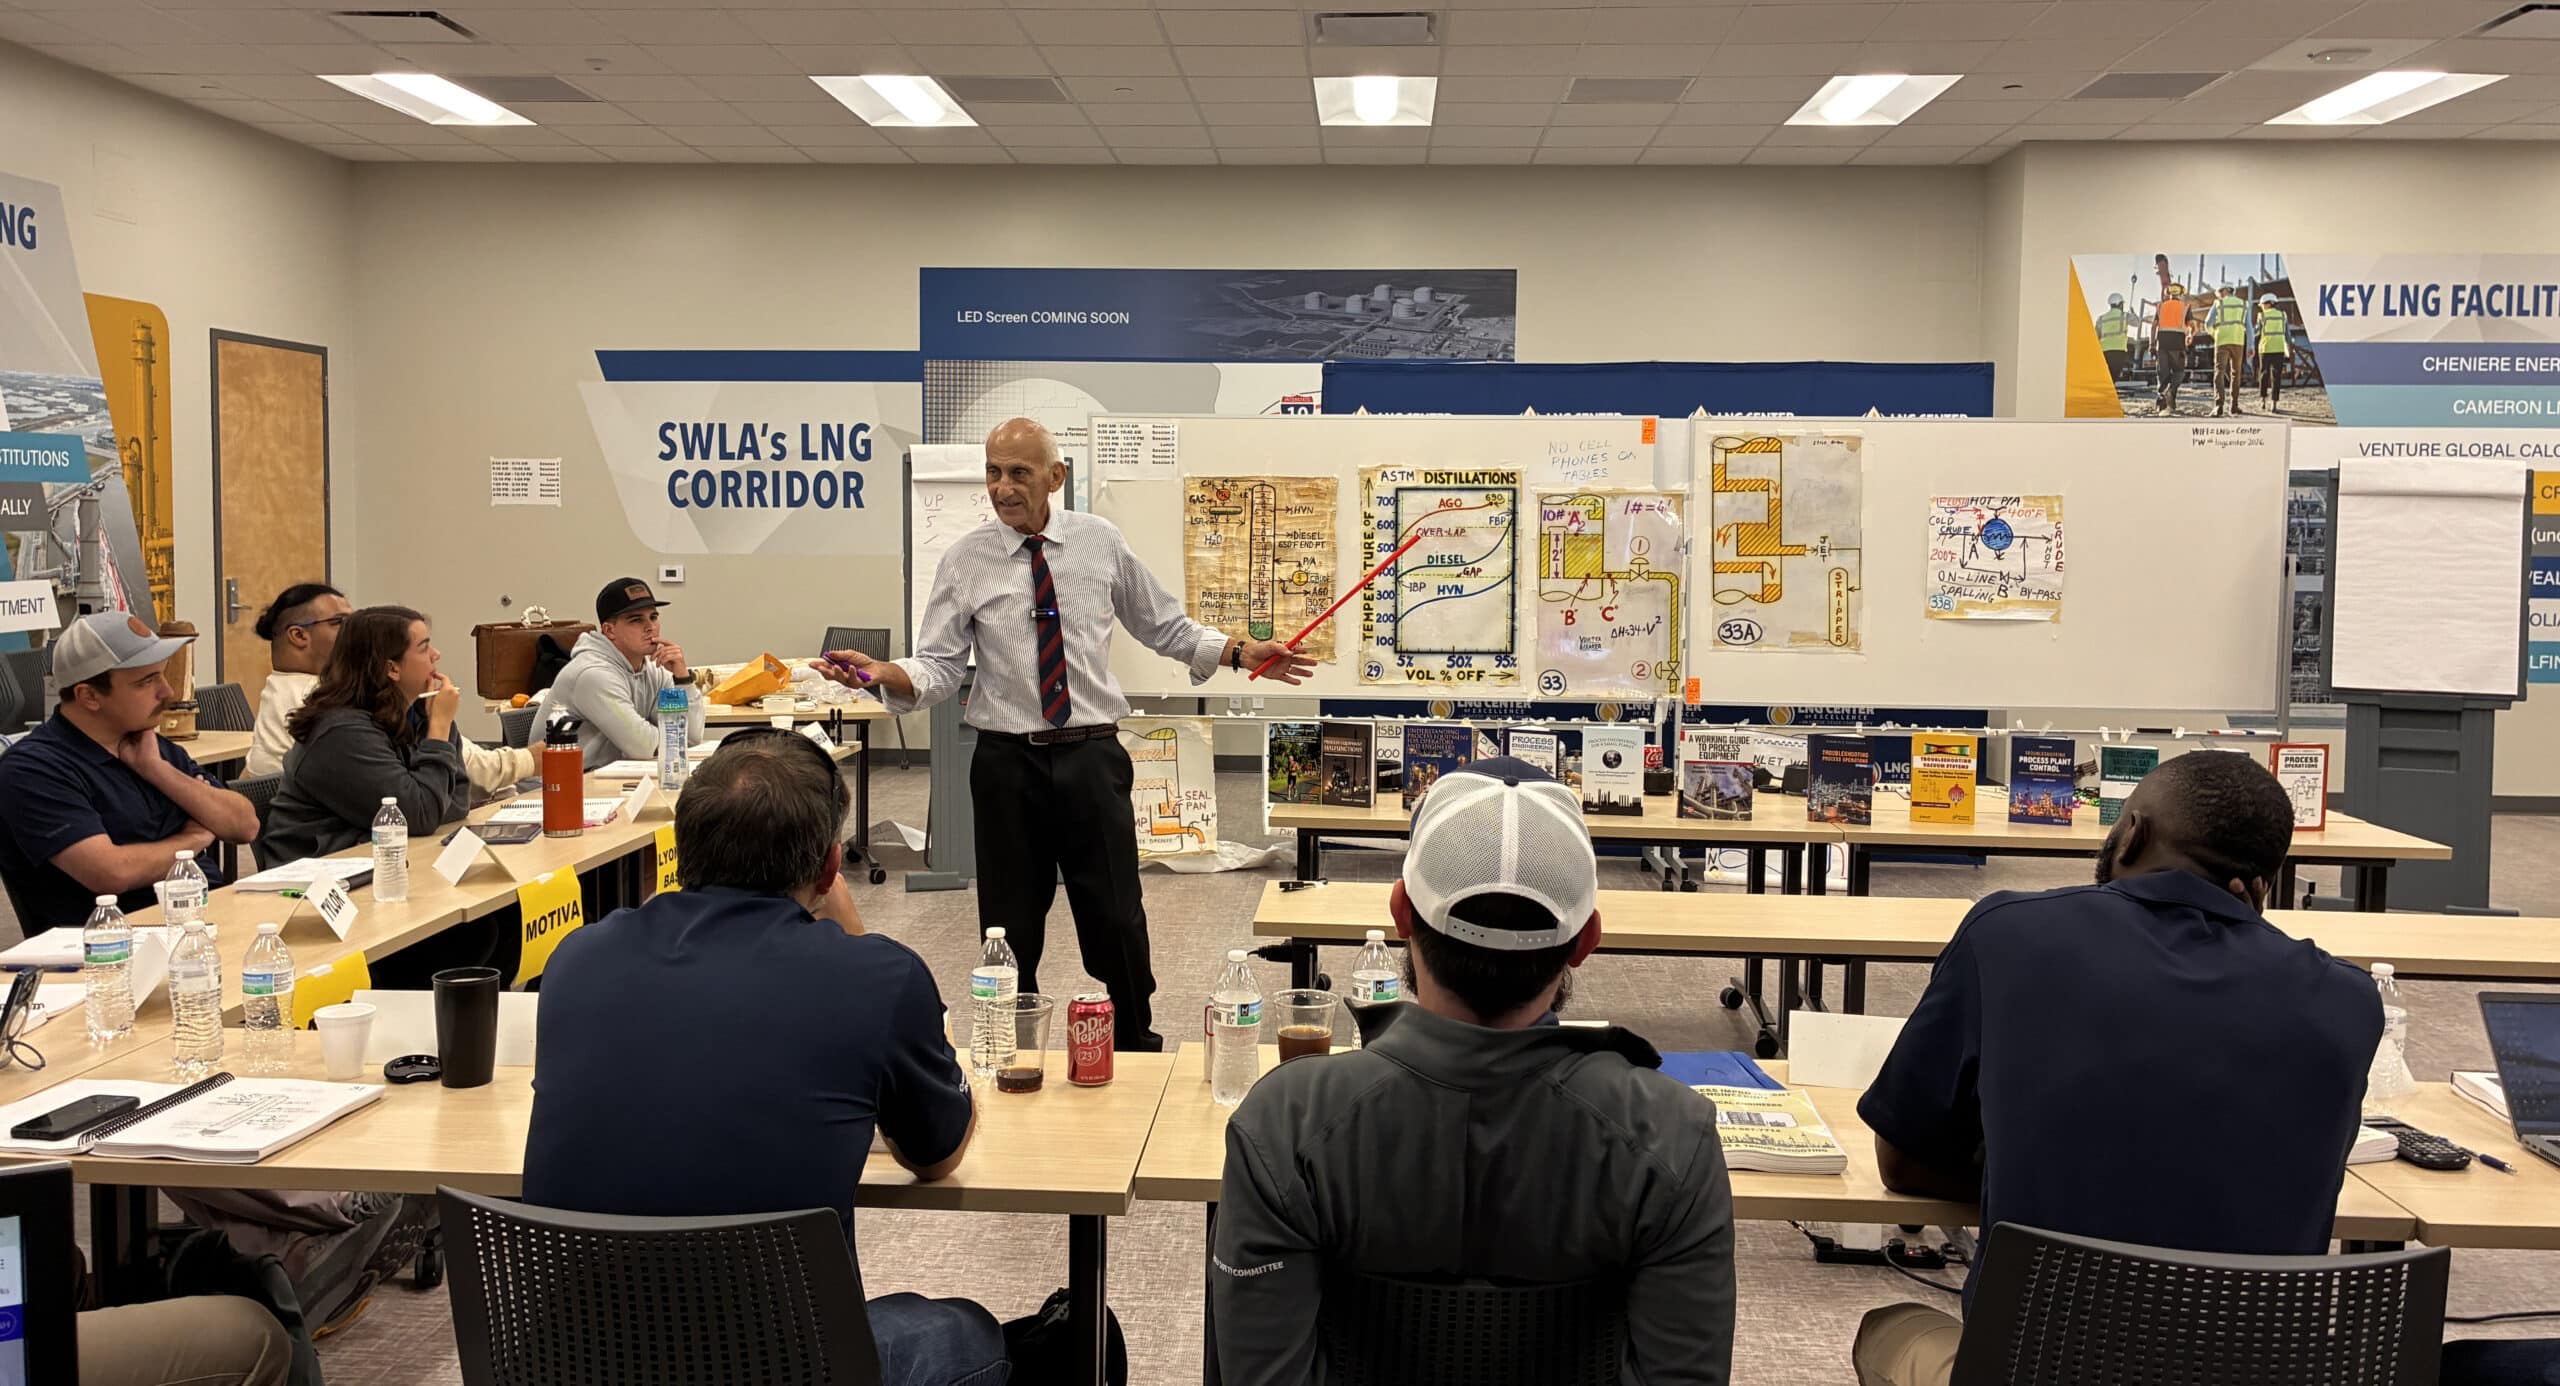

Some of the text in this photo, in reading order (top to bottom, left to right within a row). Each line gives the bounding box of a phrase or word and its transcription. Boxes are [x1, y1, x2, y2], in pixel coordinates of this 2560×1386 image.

[2319, 283, 2560, 318] KEY LNG FACILIT
[957, 311, 1129, 324] LED Screen COMING SOON
[2422, 356, 2511, 372] CHENIERE
[2453, 399, 2541, 415] CAMERON
[658, 421, 872, 462] SWLA's LNG
[2359, 442, 2441, 457] VENTURE
[2445, 443, 2515, 458] GLOBAL
[0, 449, 70, 467] TITUTIONS
[1552, 453, 1609, 468] PHONES
[1381, 471, 1517, 485] ASTM DISTILLATIONS
[668, 469, 865, 509] CORRIDOR
[924, 494, 944, 507] UP
[1377, 496, 1395, 506] 700
[1438, 498, 1463, 509] AGO
[1969, 496, 1995, 505] HOT
[2001, 496, 2020, 506] P/A
[1, 498, 32, 516] ALLY
[1377, 520, 1395, 530] 600
[1489, 515, 1506, 526] FBP
[1929, 516, 1954, 525] COLD
[1940, 526, 1972, 534] CRUDE
[1377, 543, 1395, 553] 500
[1427, 554, 1466, 565] DIESEL
[1463, 567, 1482, 577] GAP
[1938, 570, 1997, 585] ON-LINE
[1409, 582, 1426, 592] IBP
[1437, 584, 1464, 595] HVN
[1202, 592, 1248, 600] PREHEATED
[1376, 590, 1394, 600] 300
[1940, 585, 1996, 603] SPALLING
[2020, 587, 2062, 600] BY-PASS
[1835, 572, 1843, 643] STRIPPER
[1204, 615, 1236, 623] STEAM
[1376, 613, 1394, 623] 200
[1721, 624, 1755, 640] 33A
[1376, 636, 1394, 646] 100
[1396, 656, 1517, 668] 5% 50% 95%
[1367, 664, 1381, 677] 29
[1406, 670, 1486, 681] VOL % OFF
[1636, 664, 1645, 677] 2
[1542, 677, 1562, 690] 33
[1512, 736, 1554, 745] PROCESS
[1688, 735, 1750, 744] A WORKING GUIDE
[1708, 744, 1741, 752] PROCESS
[1699, 751, 1739, 760] EQUIPMENT
[2019, 756, 2071, 765] PROCESS PLANT
[1884, 762, 1910, 773] LNG
[2029, 764, 2060, 772] CONTROL
[1185, 791, 1212, 801] SEAL
[1186, 801, 1206, 810] PAN
[526, 900, 580, 943] MOTIVA
[1088, 1017, 1105, 1031] Dr
[1073, 1020, 1112, 1045] Pepper
[1232, 1261, 1284, 1277] COMMITTEE
